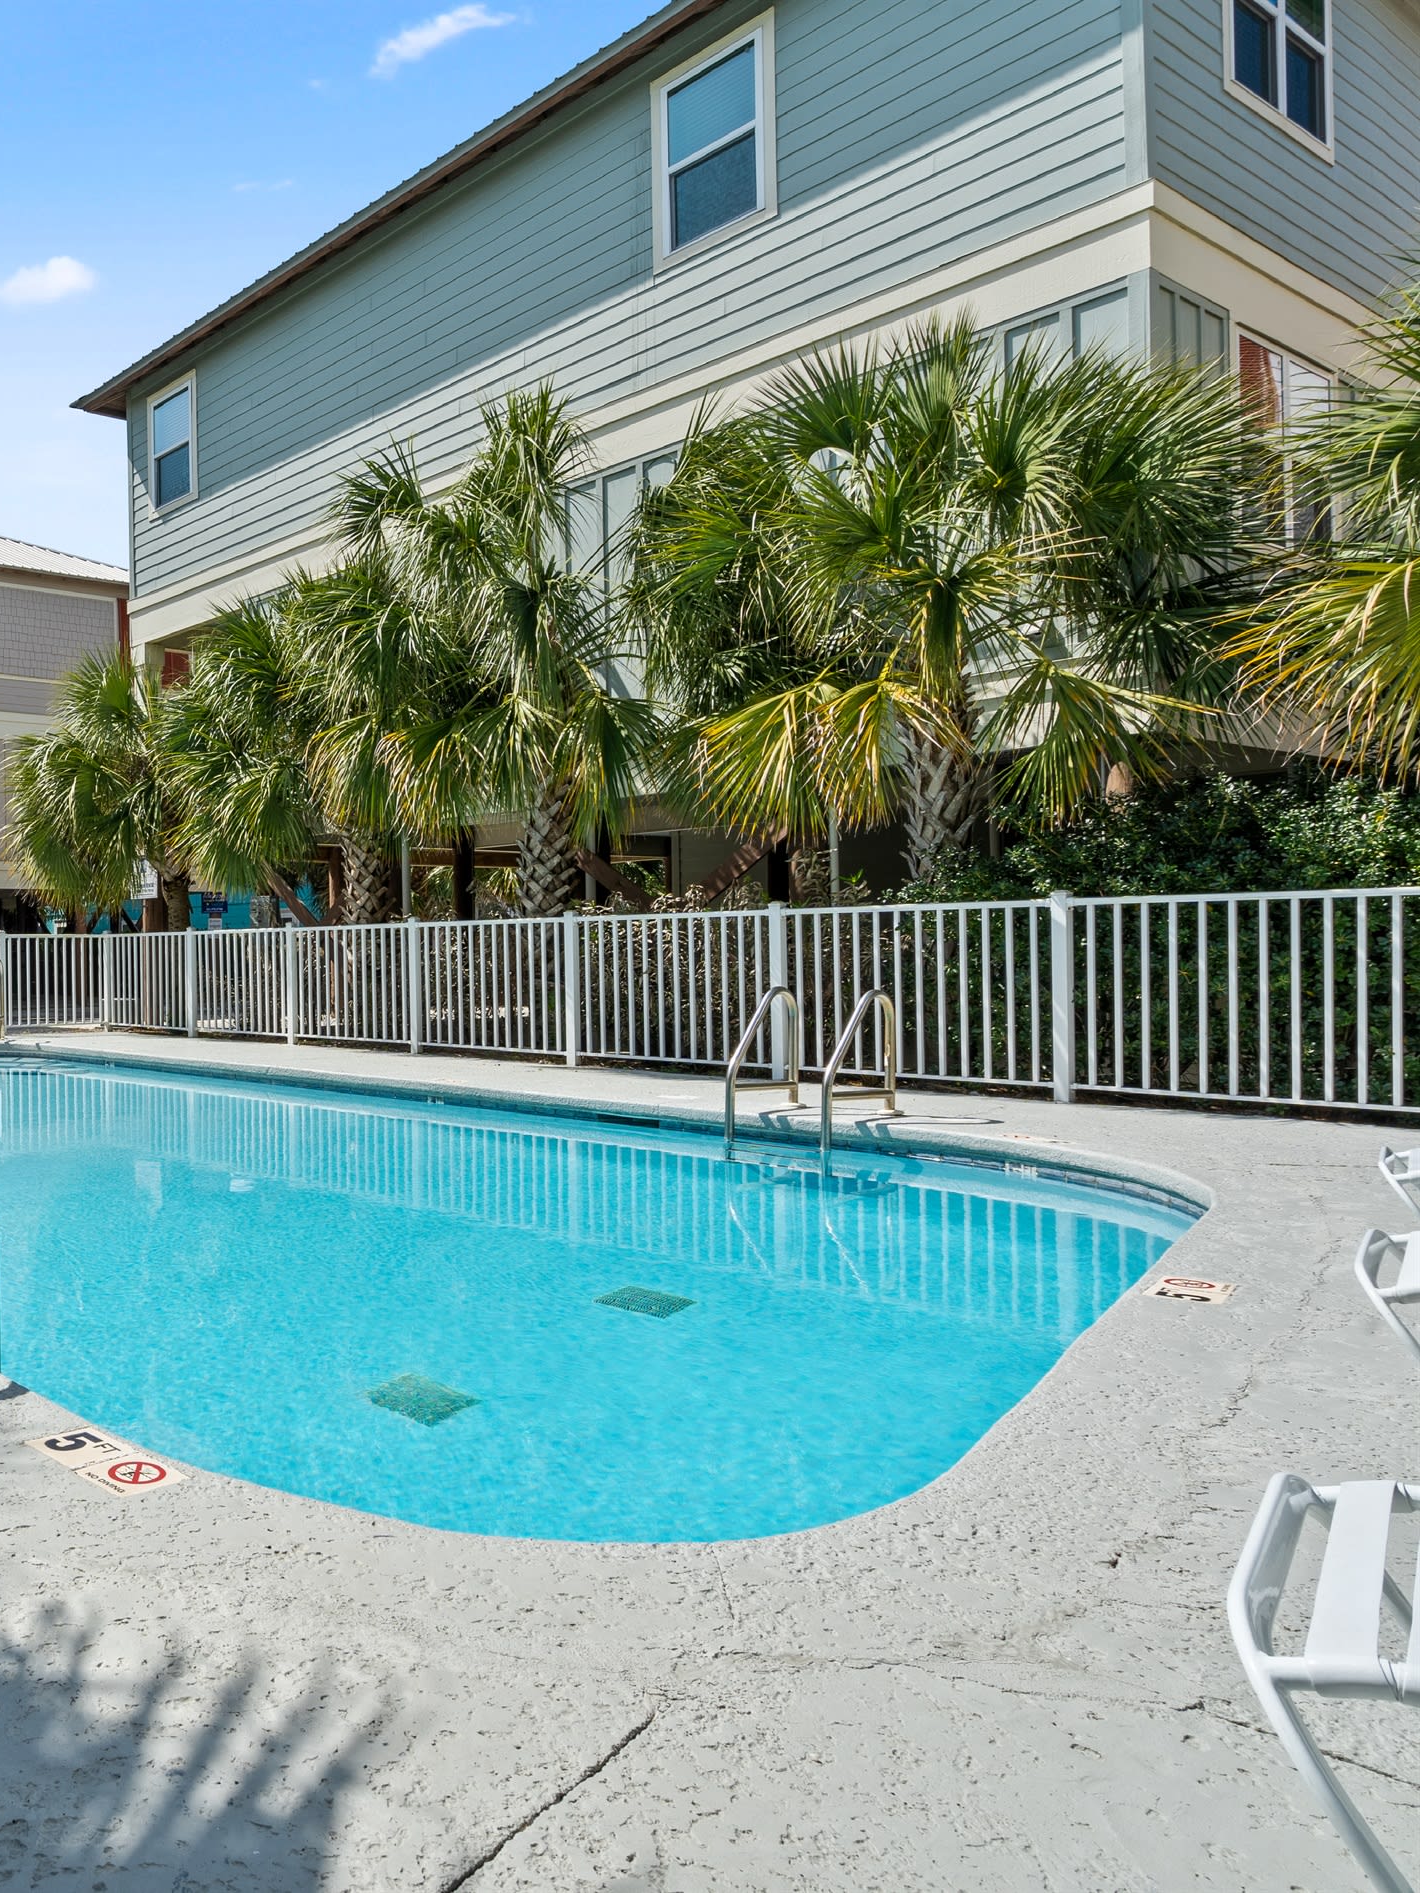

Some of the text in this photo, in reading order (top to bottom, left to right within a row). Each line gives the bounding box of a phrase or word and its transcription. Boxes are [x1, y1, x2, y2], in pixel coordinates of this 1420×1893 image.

[44, 1431, 121, 1454] 5 FT
[85, 1472, 125, 1493] NO DIVING
